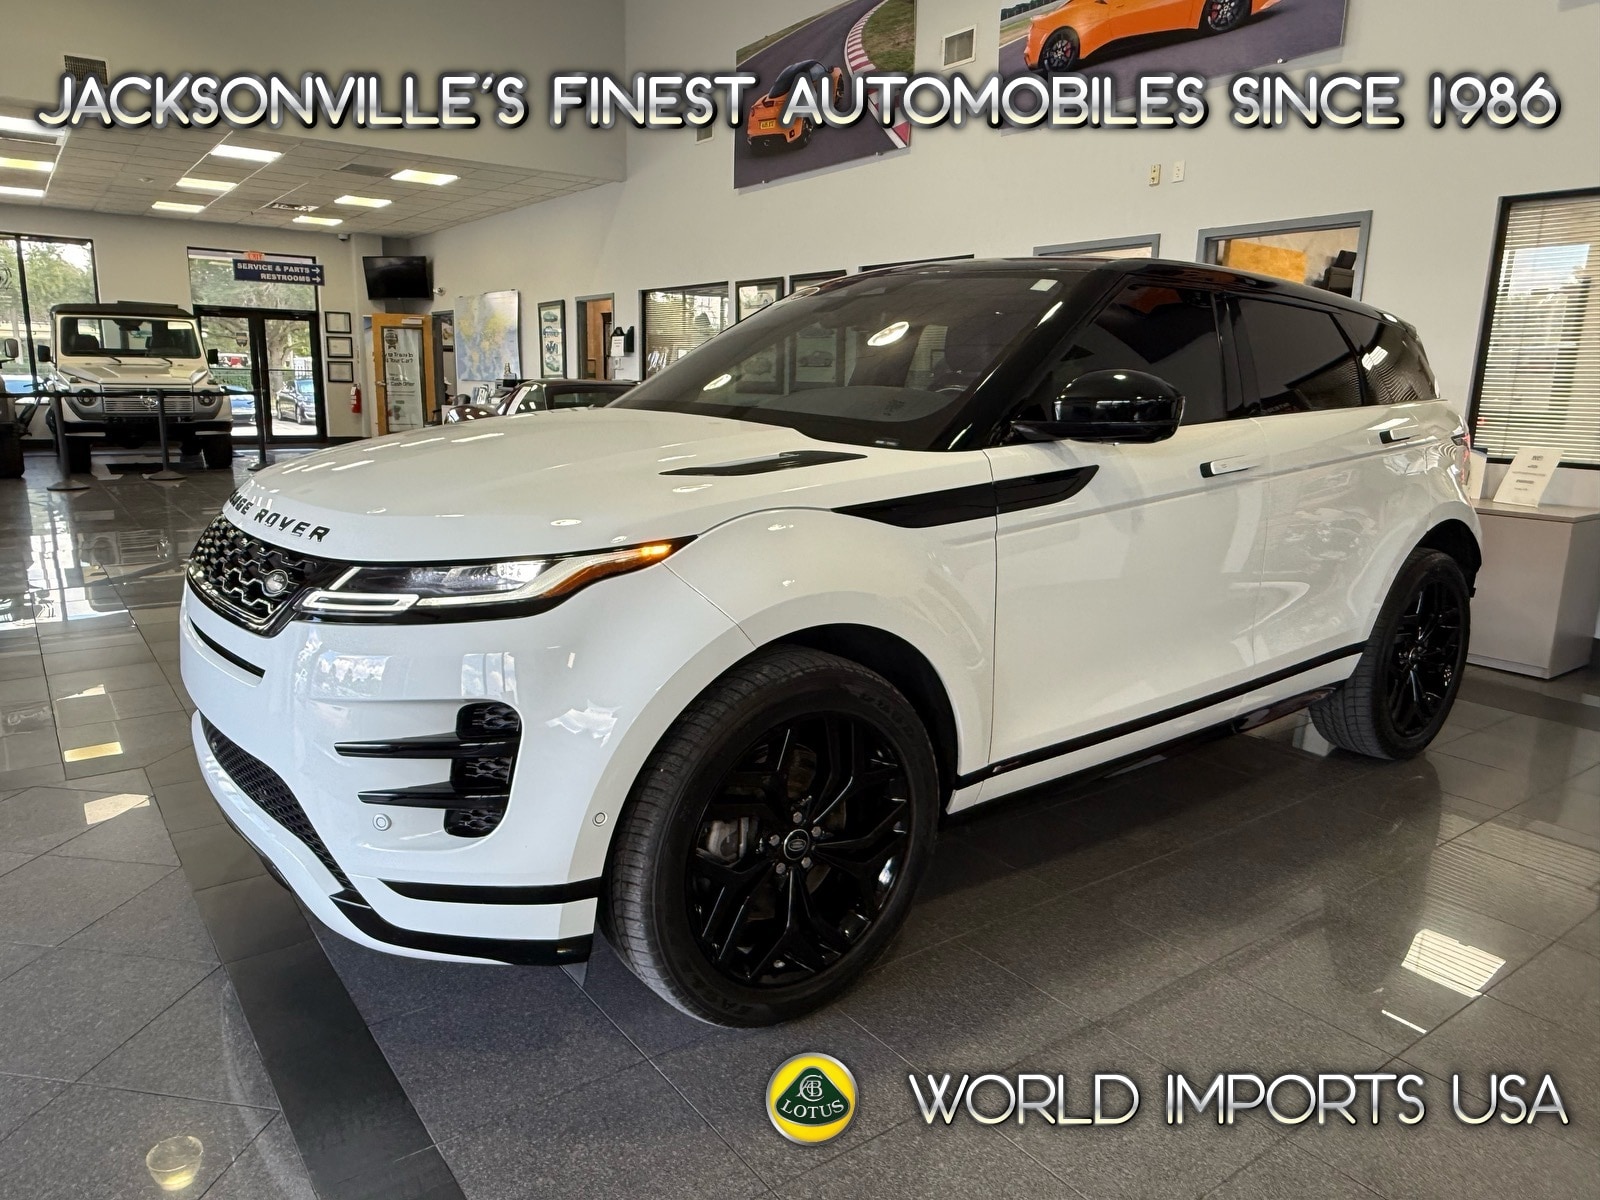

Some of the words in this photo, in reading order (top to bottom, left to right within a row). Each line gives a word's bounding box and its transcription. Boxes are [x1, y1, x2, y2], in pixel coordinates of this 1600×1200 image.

[237, 262, 273, 272] SERVICE
[283, 265, 310, 274] PARTS
[260, 273, 311, 282] RESTROOMS
[253, 508, 331, 543] ROVER
